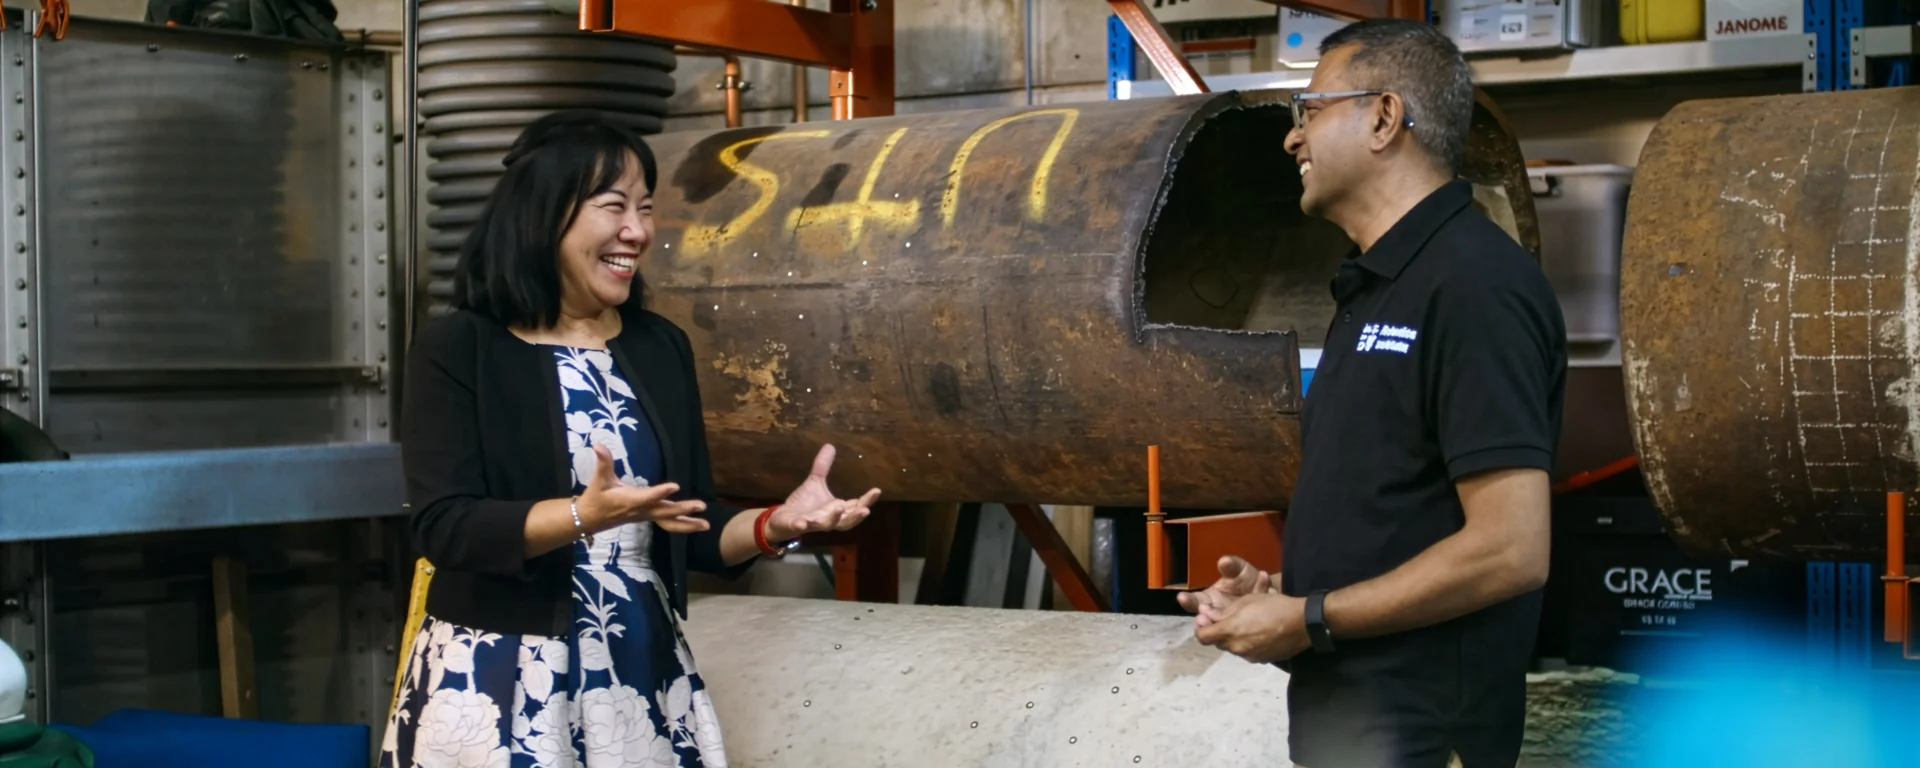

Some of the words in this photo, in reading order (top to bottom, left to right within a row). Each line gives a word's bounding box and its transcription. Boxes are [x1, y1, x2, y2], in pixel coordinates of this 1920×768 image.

[1715, 15, 1789, 35] JANOME
[673, 108, 1080, 264] UTS
[1604, 567, 1713, 595] GRACE
